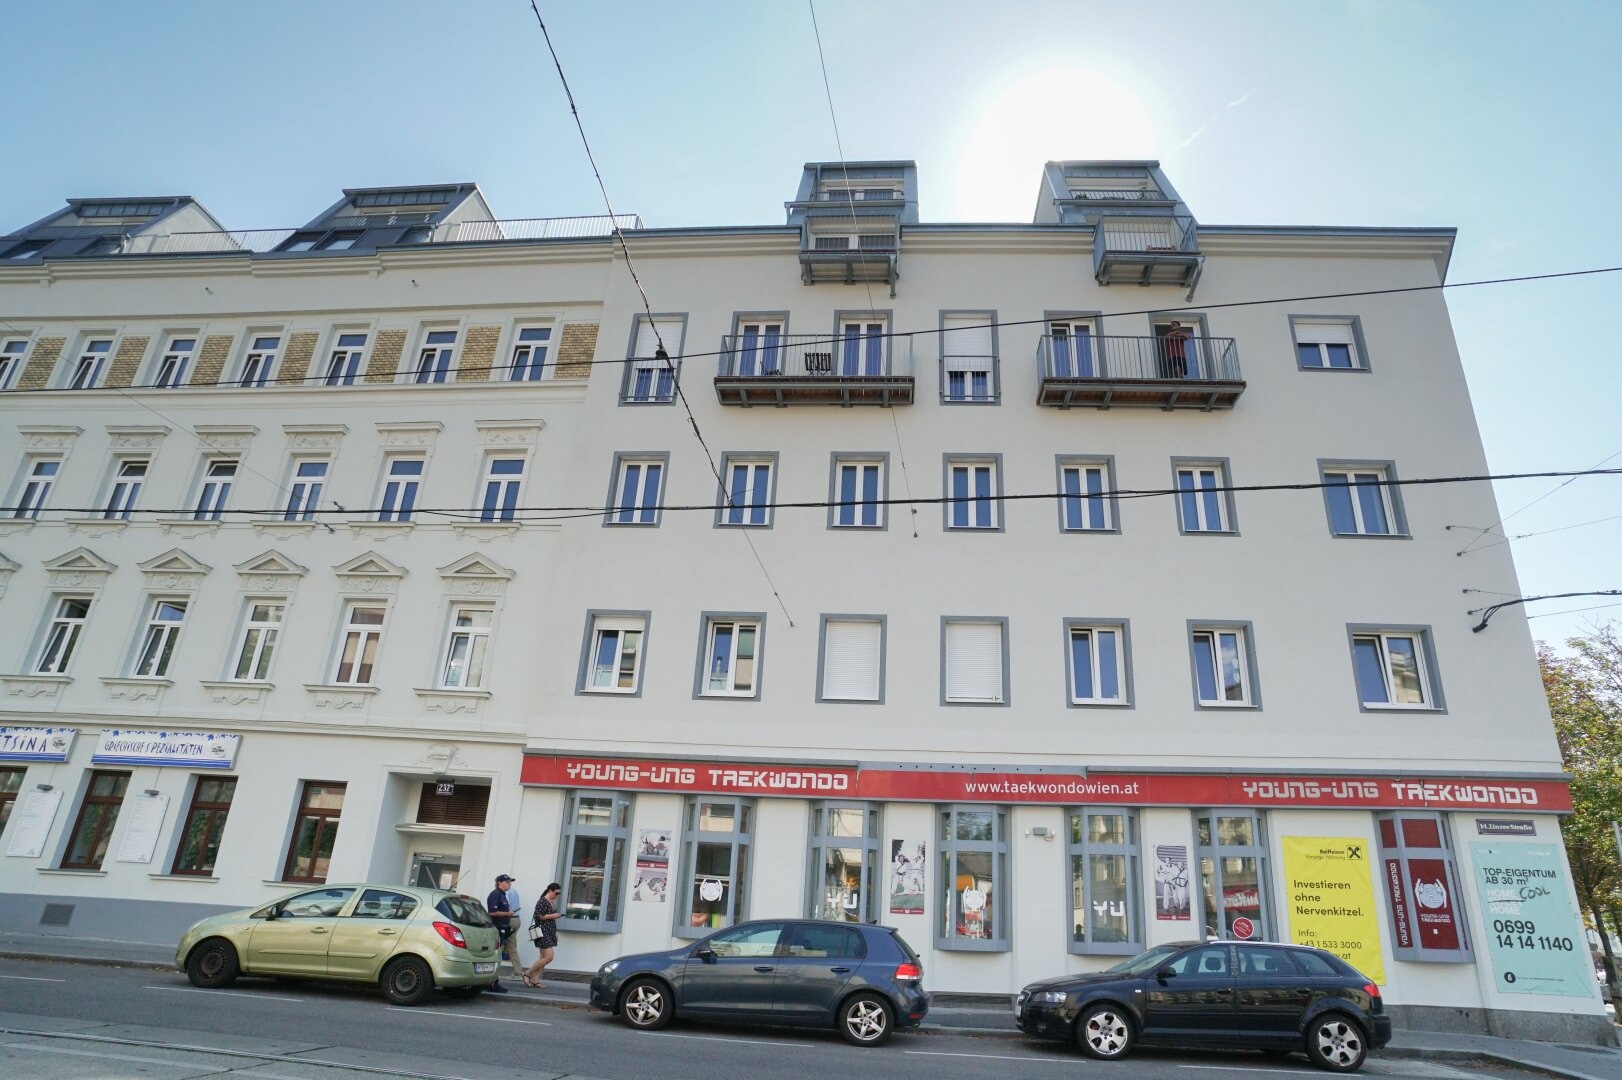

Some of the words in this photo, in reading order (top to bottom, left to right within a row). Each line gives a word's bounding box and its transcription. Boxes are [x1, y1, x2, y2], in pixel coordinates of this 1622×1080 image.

[567, 763, 695, 784] YOUNG-UNG
[708, 769, 848, 790] TAEKWONDO
[965, 780, 1139, 795] www.taekwondowien.at
[1242, 781, 1379, 798] YOUNG-UNG
[1391, 783, 1538, 805] TAEKWONDO
[1483, 867, 1557, 879] TOP-EIGENTUM
[1293, 880, 1351, 890] Investieren
[1485, 876, 1499, 885] AB
[1501, 876, 1514, 886] 30
[1294, 893, 1321, 902] ohne
[1487, 888, 1518, 898] HOME
[1296, 906, 1365, 917] Nervenkitzel.
[1490, 905, 1521, 915] HOME
[1493, 919, 1536, 935] 0699
[1298, 929, 1318, 937] Info:
[1323, 941, 1338, 949] 533
[1340, 942, 1363, 950] 3000
[1496, 934, 1514, 949] 14
[1517, 935, 1535, 950] 14
[1538, 936, 1574, 952] 1140
